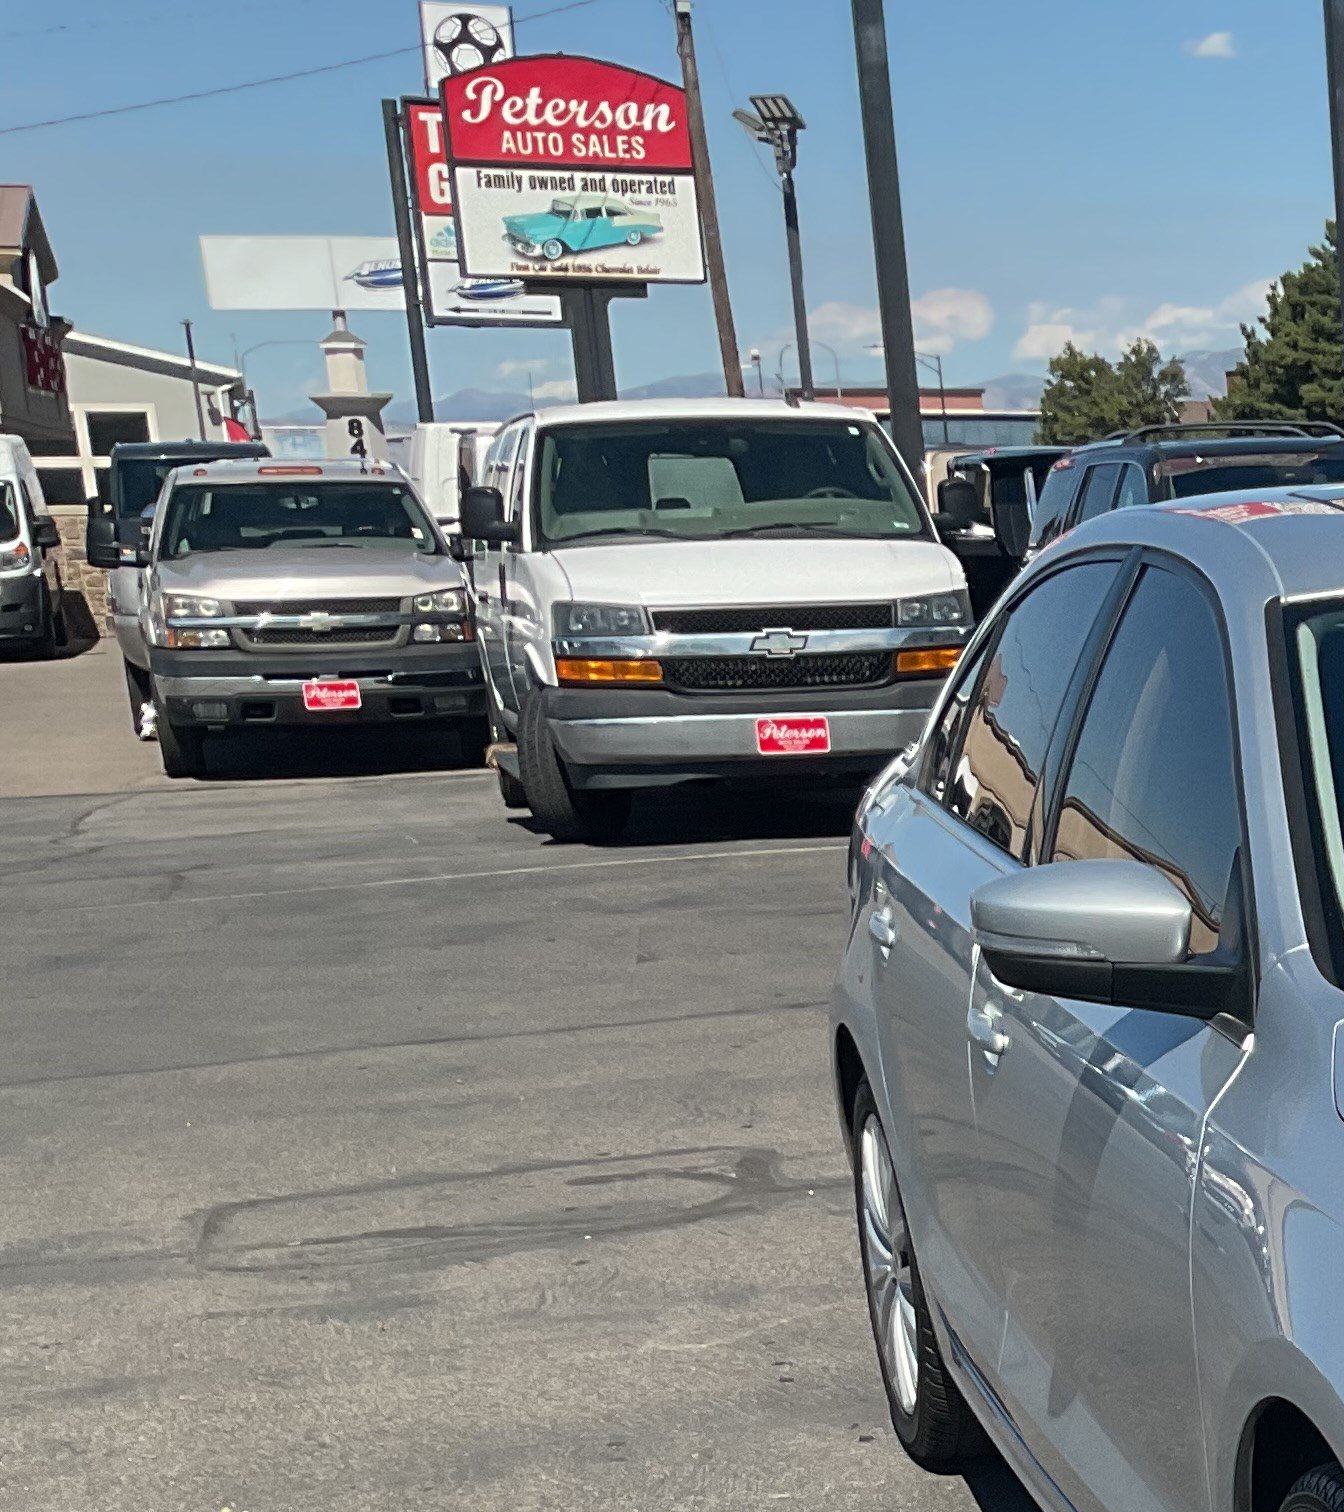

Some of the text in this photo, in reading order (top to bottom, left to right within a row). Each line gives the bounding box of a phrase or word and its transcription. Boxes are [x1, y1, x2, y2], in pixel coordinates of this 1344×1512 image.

[461, 76, 676, 133] Peterson
[501, 130, 646, 160] AUTO SALES
[476, 169, 676, 197] Family owned and operated
[759, 722, 826, 740] Peterson
